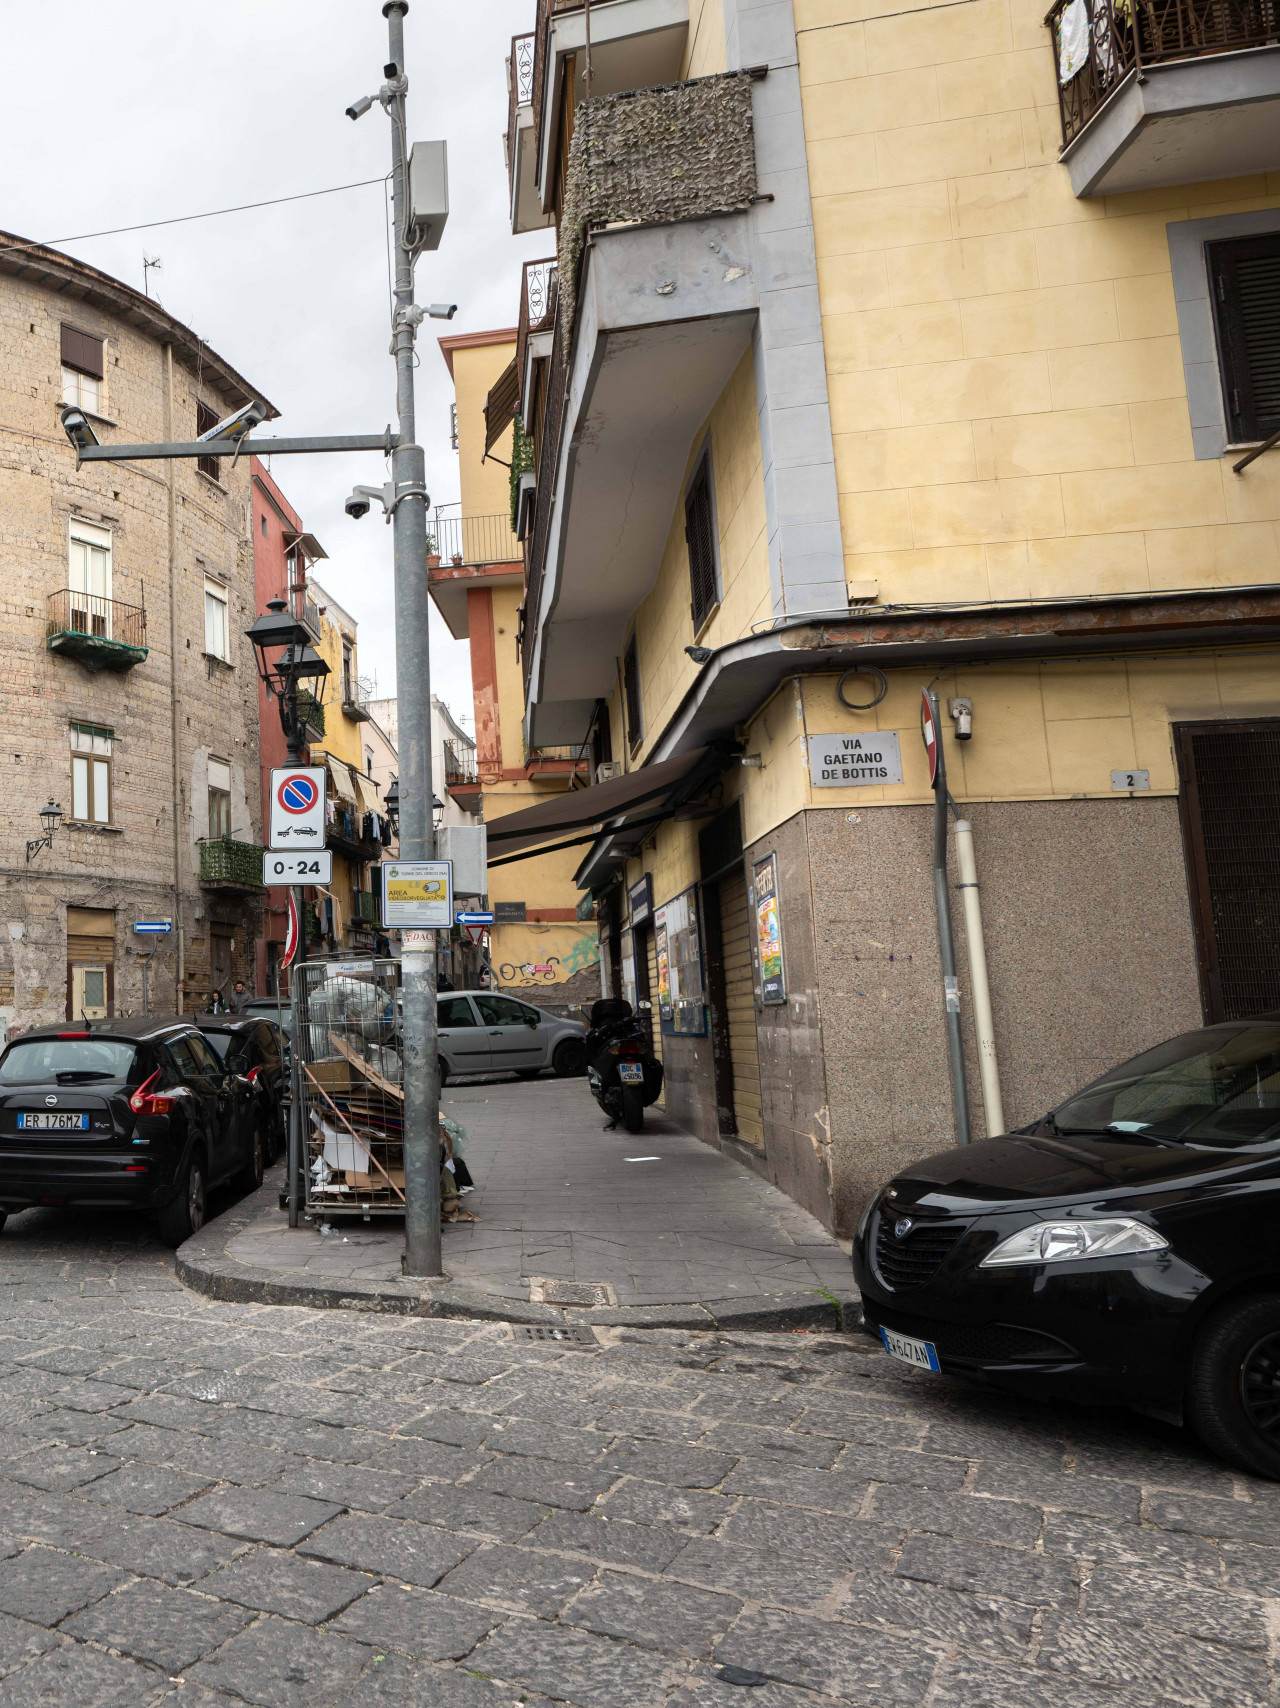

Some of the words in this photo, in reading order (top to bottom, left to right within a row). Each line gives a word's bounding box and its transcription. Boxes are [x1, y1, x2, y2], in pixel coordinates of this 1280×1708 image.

[842, 739, 862, 750] VIA
[823, 752, 883, 765] GAETANO
[821, 769, 839, 780] DE
[842, 767, 888, 779] BOTTIS
[1126, 774, 1135, 786] 2
[273, 861, 285, 875] 0
[296, 861, 321, 875] 24
[25, 1115, 40, 1128] ER
[45, 1115, 81, 1128] 176MZ
[897, 1339, 930, 1365] 647AN
